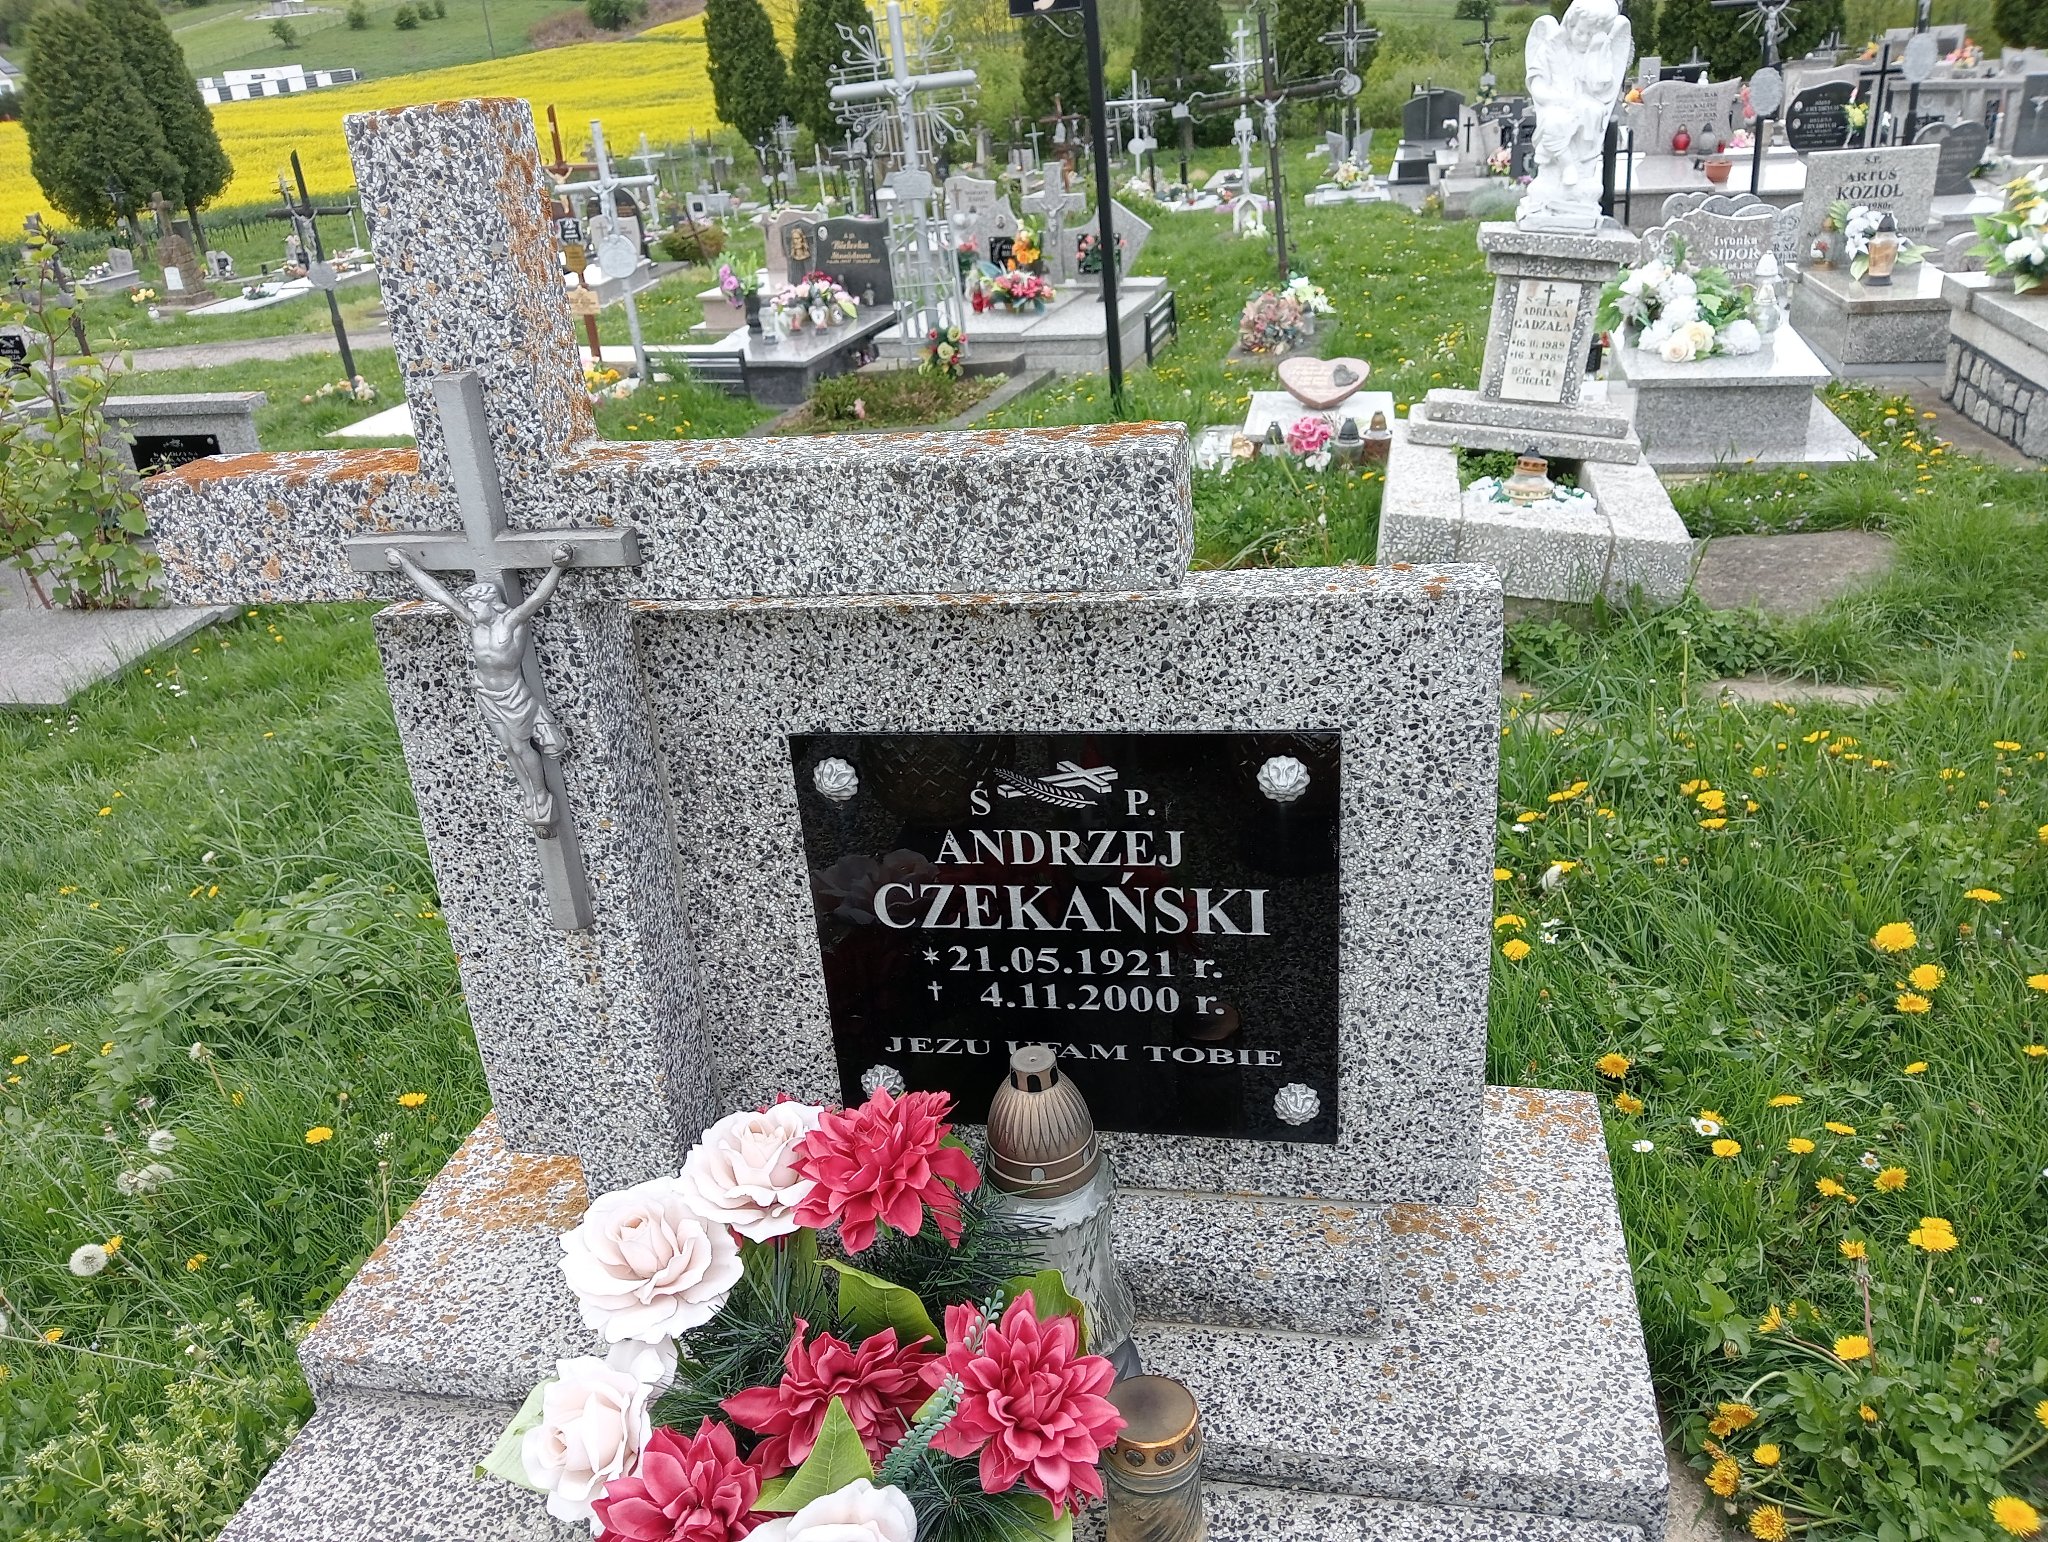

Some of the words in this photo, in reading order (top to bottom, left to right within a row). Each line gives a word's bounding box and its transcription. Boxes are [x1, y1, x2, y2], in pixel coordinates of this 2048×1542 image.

[1125, 789, 1156, 816] P.
[935, 829, 1185, 868] ANDRZEJ
[873, 871, 1271, 936] CZEKAŃSKI
[1193, 958, 1223, 980] r.
[980, 984, 1180, 1014] 4.11.2000
[1195, 995, 1225, 1015] r.
[885, 1036, 990, 1055] JEZU
[1142, 1045, 1283, 1067] TOBIE
